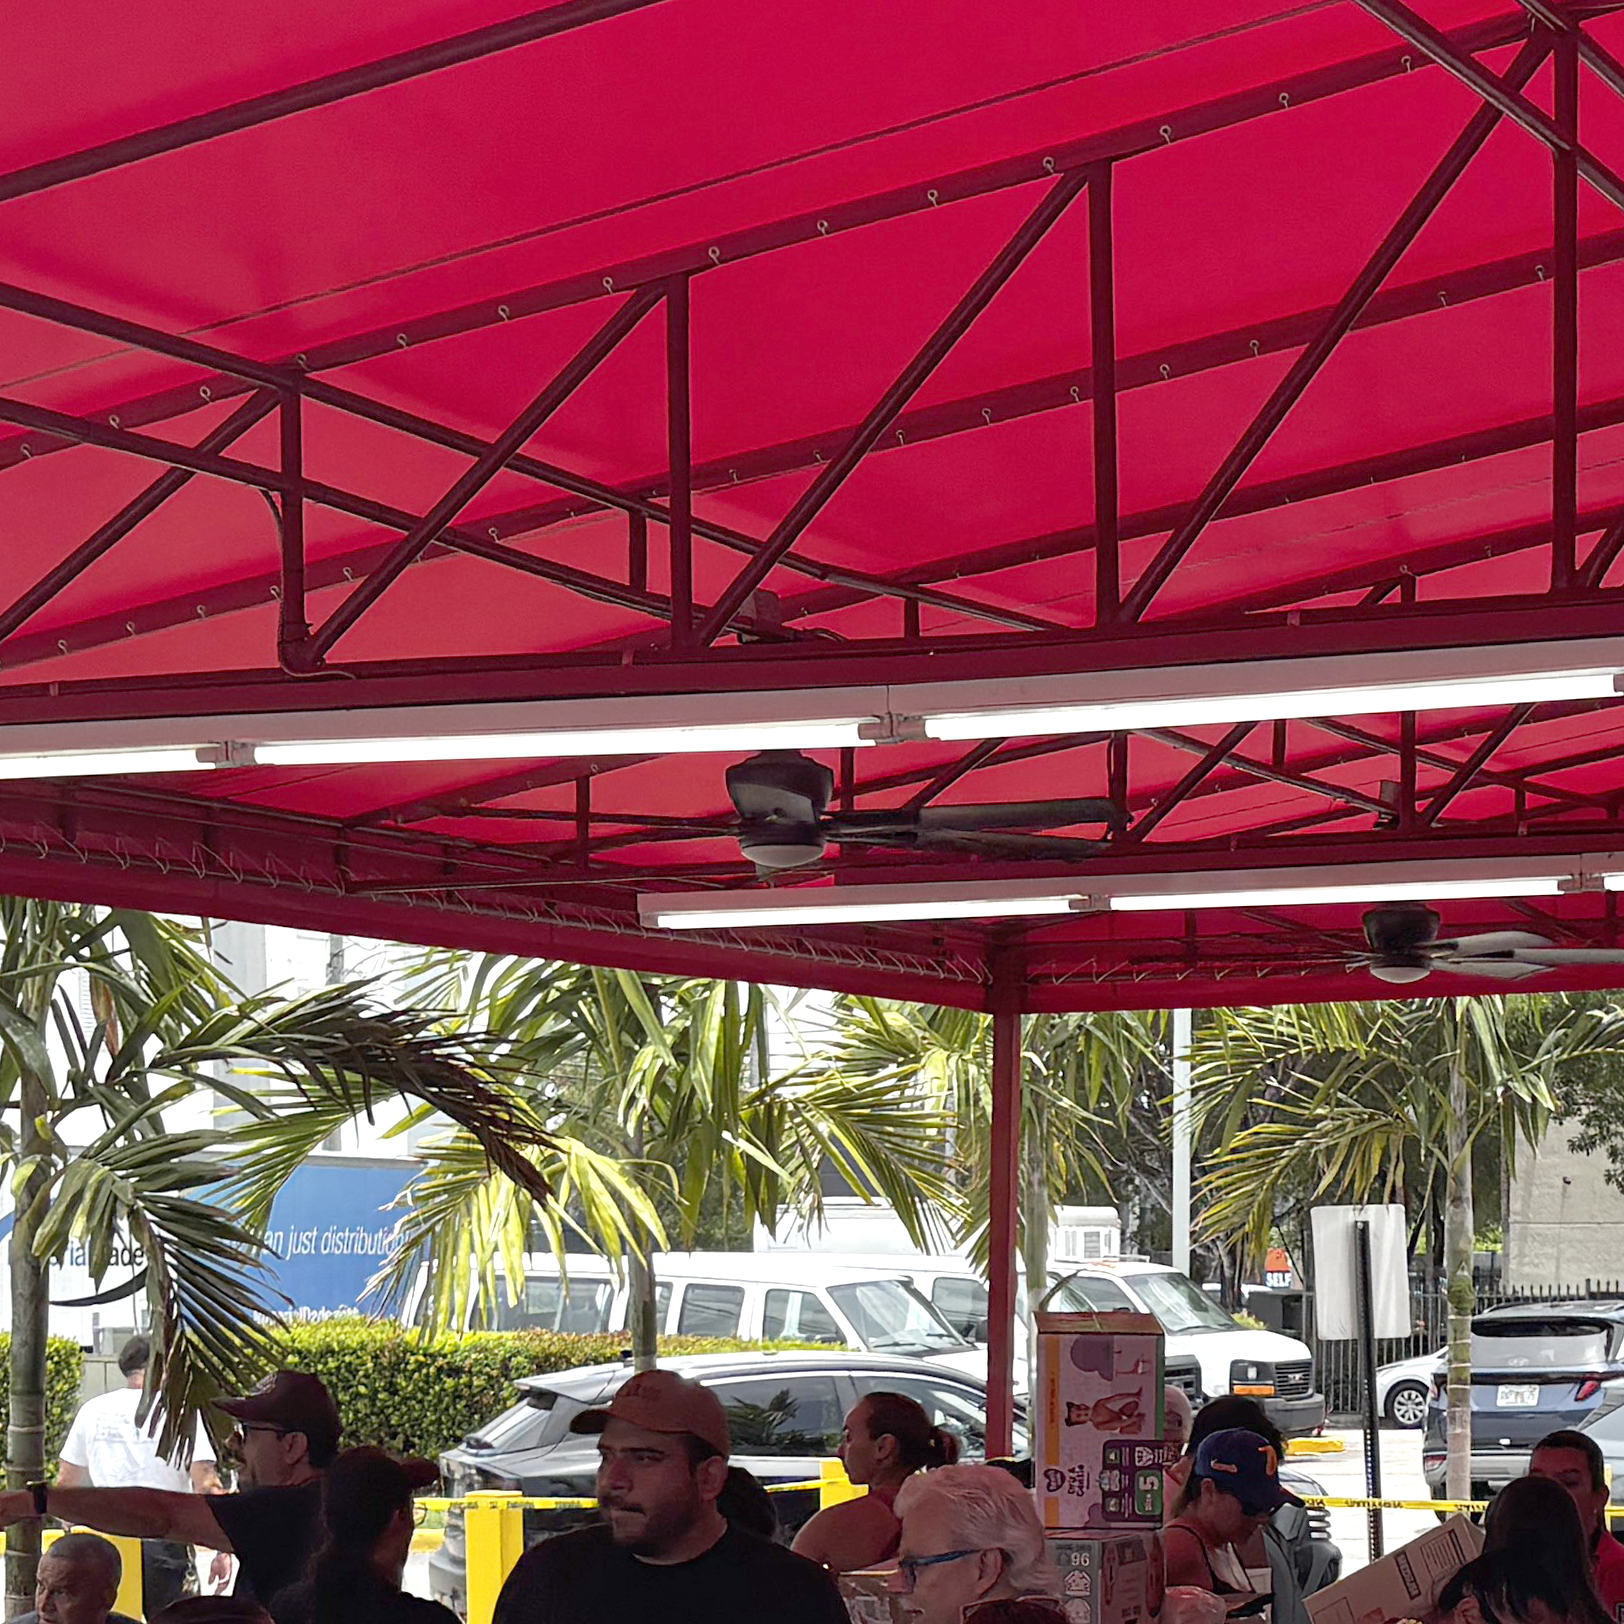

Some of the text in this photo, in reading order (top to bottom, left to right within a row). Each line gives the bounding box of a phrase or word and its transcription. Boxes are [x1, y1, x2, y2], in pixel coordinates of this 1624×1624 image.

[285, 1225, 318, 1260] just
[1266, 1272, 1292, 1287] SELF
[1070, 1552, 1091, 1567] 96
